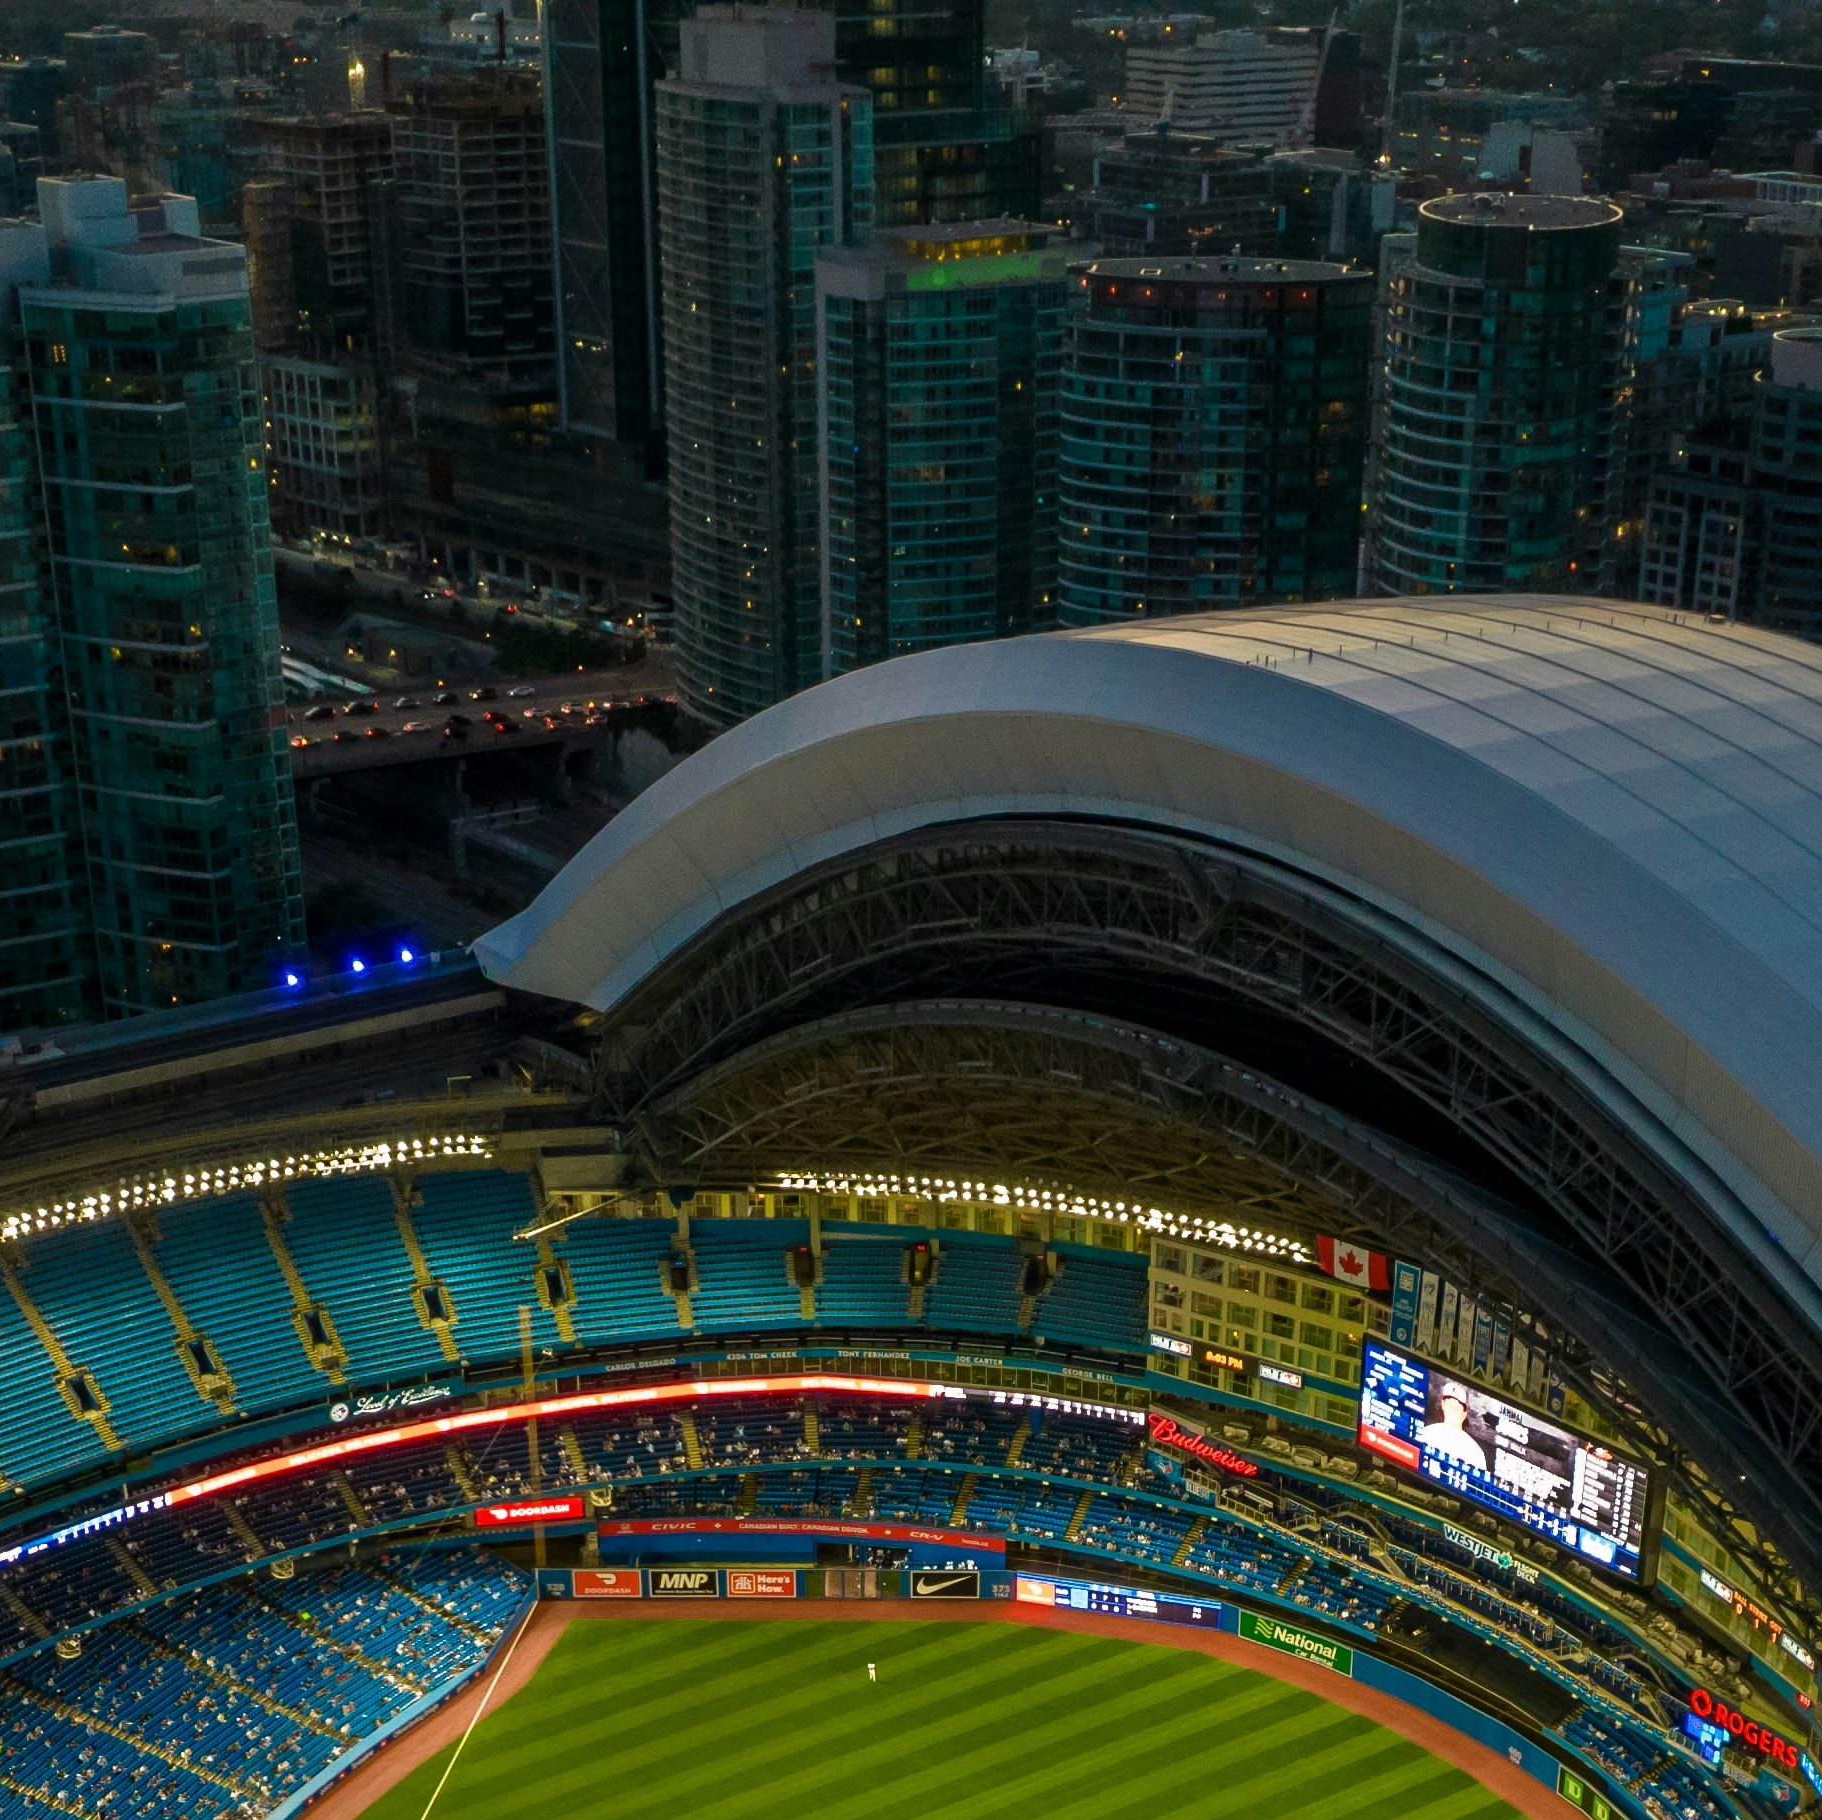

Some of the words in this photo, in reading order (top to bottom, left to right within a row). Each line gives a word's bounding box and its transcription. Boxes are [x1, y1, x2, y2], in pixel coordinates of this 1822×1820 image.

[838, 1350, 860, 1358] TONY
[862, 1351, 910, 1360] FERNANDEZ
[955, 1355, 972, 1363] JOE
[974, 1356, 1004, 1366] CARTER
[605, 1363, 636, 1373] CARLOS
[638, 1358, 677, 1370] DELGADO
[1096, 1372, 1115, 1383] BELL
[1148, 1413, 1260, 1477] Budweiser
[509, 1503, 570, 1518] DOORDASH
[651, 1522, 697, 1531] CIVIC
[910, 1531, 944, 1542] CR-V
[1444, 1523, 1498, 1561] WESTJET
[1513, 1559, 1540, 1578] FLIGHT
[660, 1573, 708, 1590] MNP
[757, 1574, 790, 1585] Here's
[1517, 1569, 1536, 1584] DECK
[757, 1584, 785, 1593] How.
[1735, 1603, 1744, 1615] 0
[1273, 1624, 1338, 1661] National
[1294, 1647, 1309, 1658] Car
[1309, 1652, 1334, 1669] Rental
[1714, 1702, 1798, 1769] ROGERS
[1566, 1778, 1582, 1799] TD
